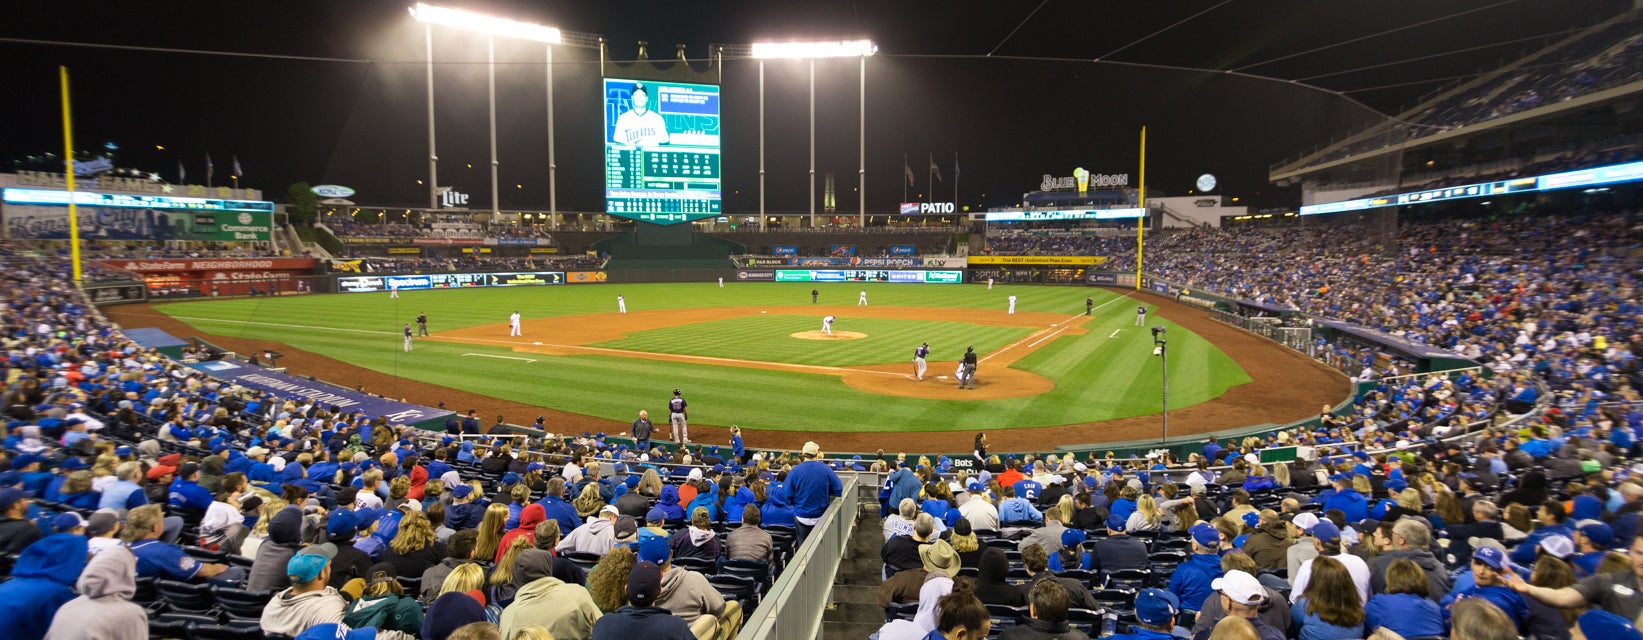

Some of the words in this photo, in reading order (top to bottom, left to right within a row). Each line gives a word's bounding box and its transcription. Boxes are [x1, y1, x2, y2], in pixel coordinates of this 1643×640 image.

[1041, 174, 1075, 191] BLUE
[1090, 173, 1128, 187] MOON
[442, 189, 469, 207] Lite
[921, 202, 954, 214] PATIO
[221, 224, 268, 232] Commerce
[234, 232, 258, 240] Bank
[191, 260, 273, 269] NEIGHBORHOOD
[864, 258, 885, 266] PEPSI
[887, 258, 913, 266] PORCH
[388, 278, 429, 288] Spectrum
[954, 459, 973, 467] Bats
[1026, 489, 1035, 498] 6
